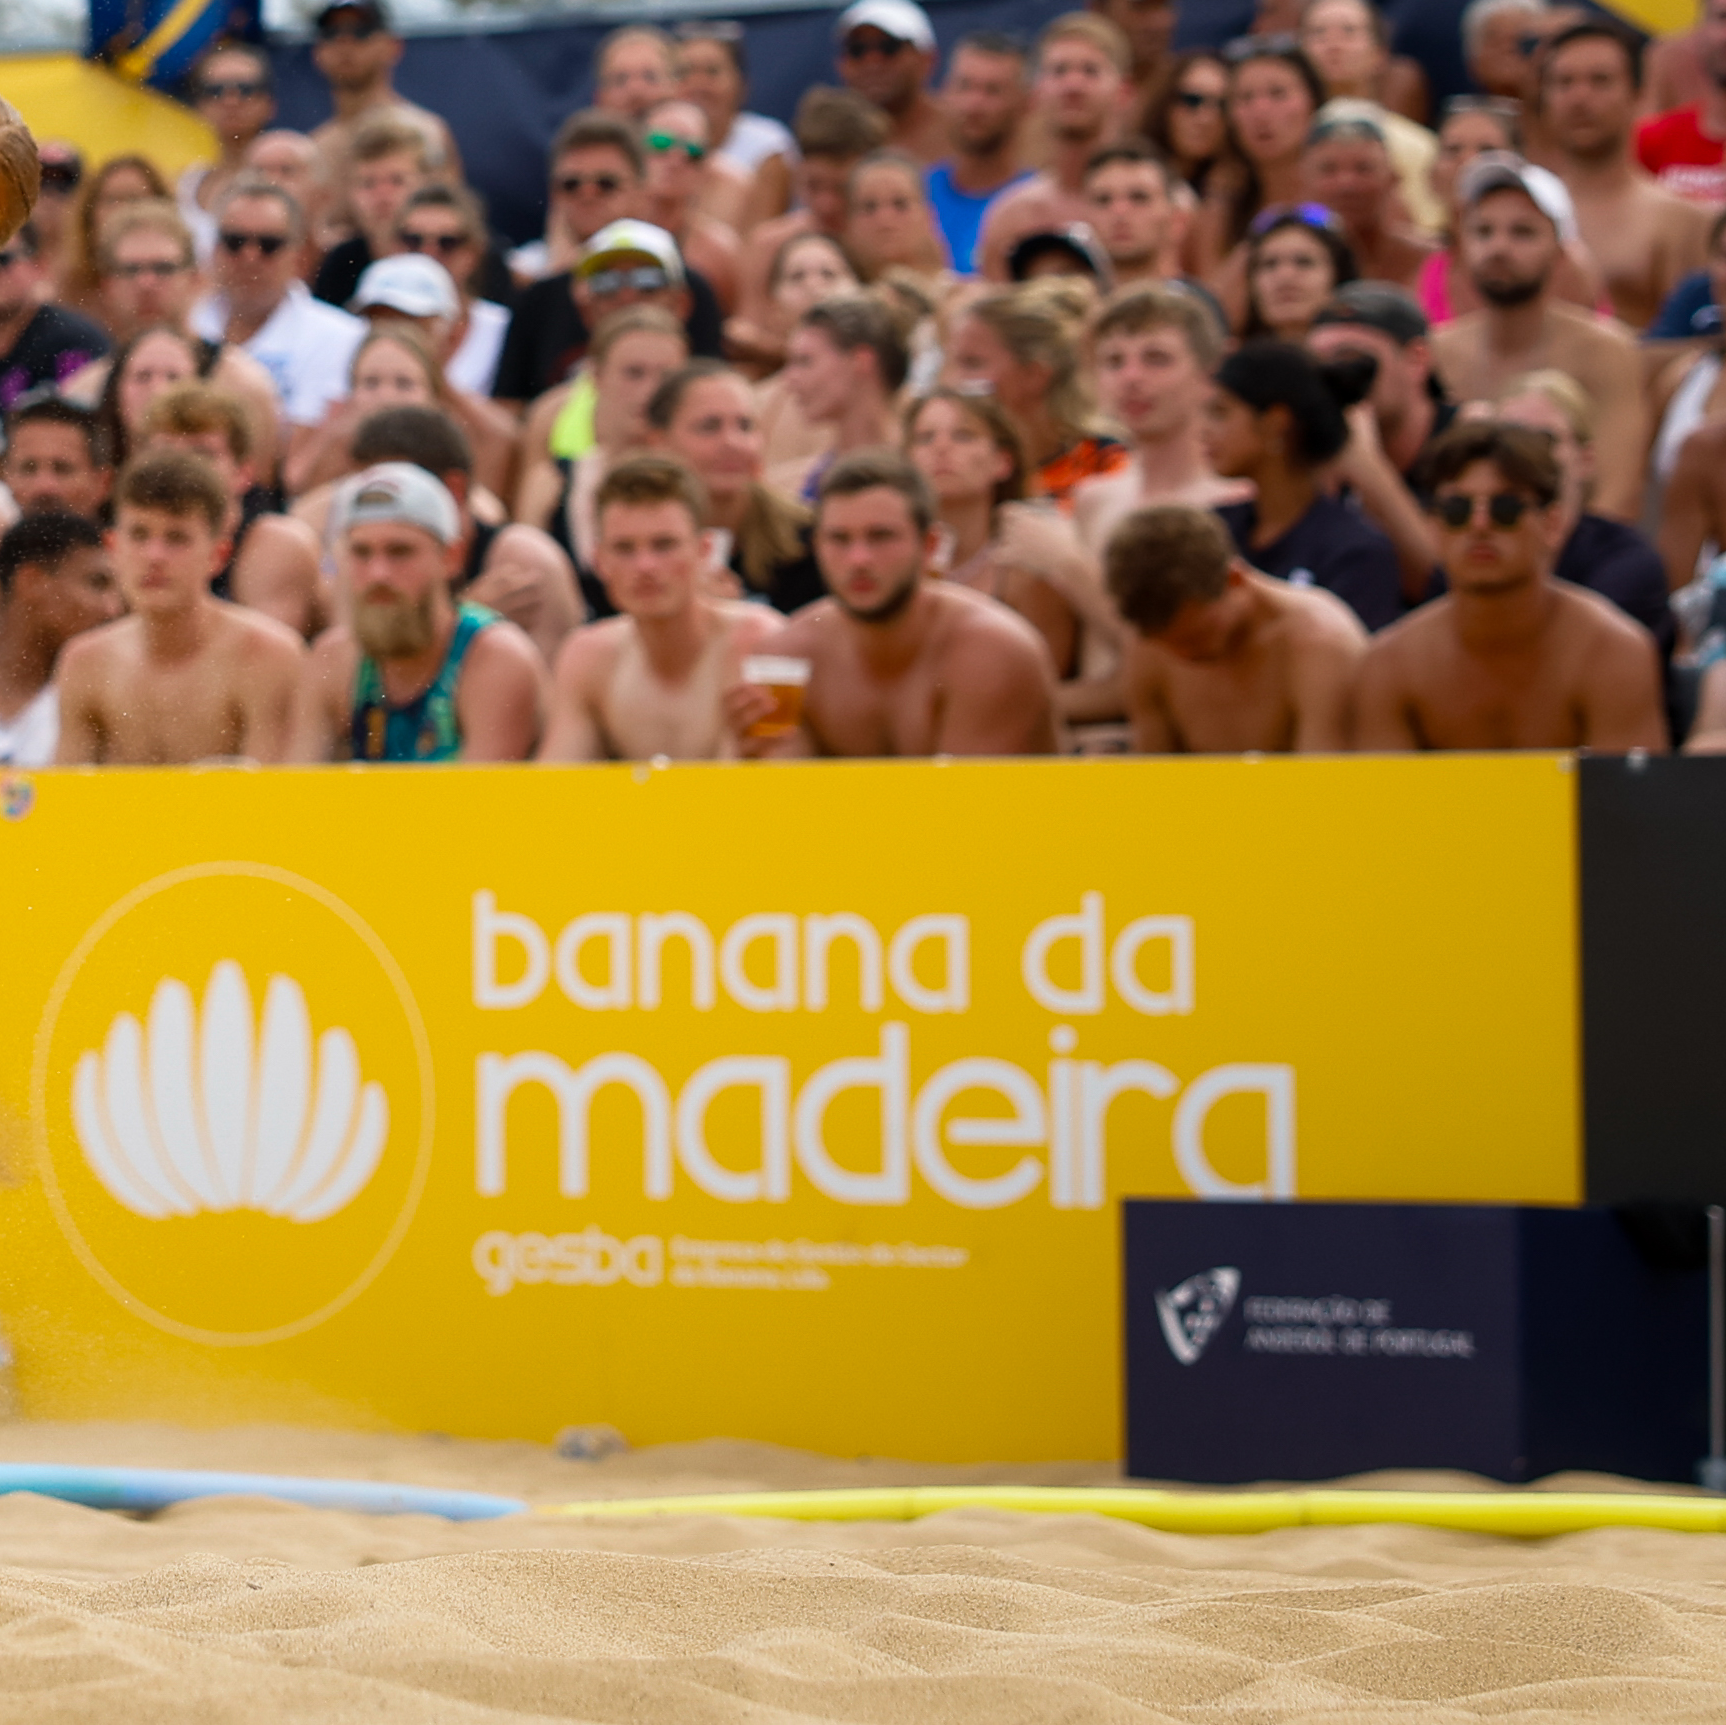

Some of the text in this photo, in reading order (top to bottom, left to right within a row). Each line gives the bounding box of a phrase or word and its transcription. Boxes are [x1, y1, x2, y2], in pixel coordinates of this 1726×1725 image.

[472, 887, 1196, 1015] banana da
[475, 1020, 1298, 1211] madeira
[471, 1223, 665, 1297] gesba
